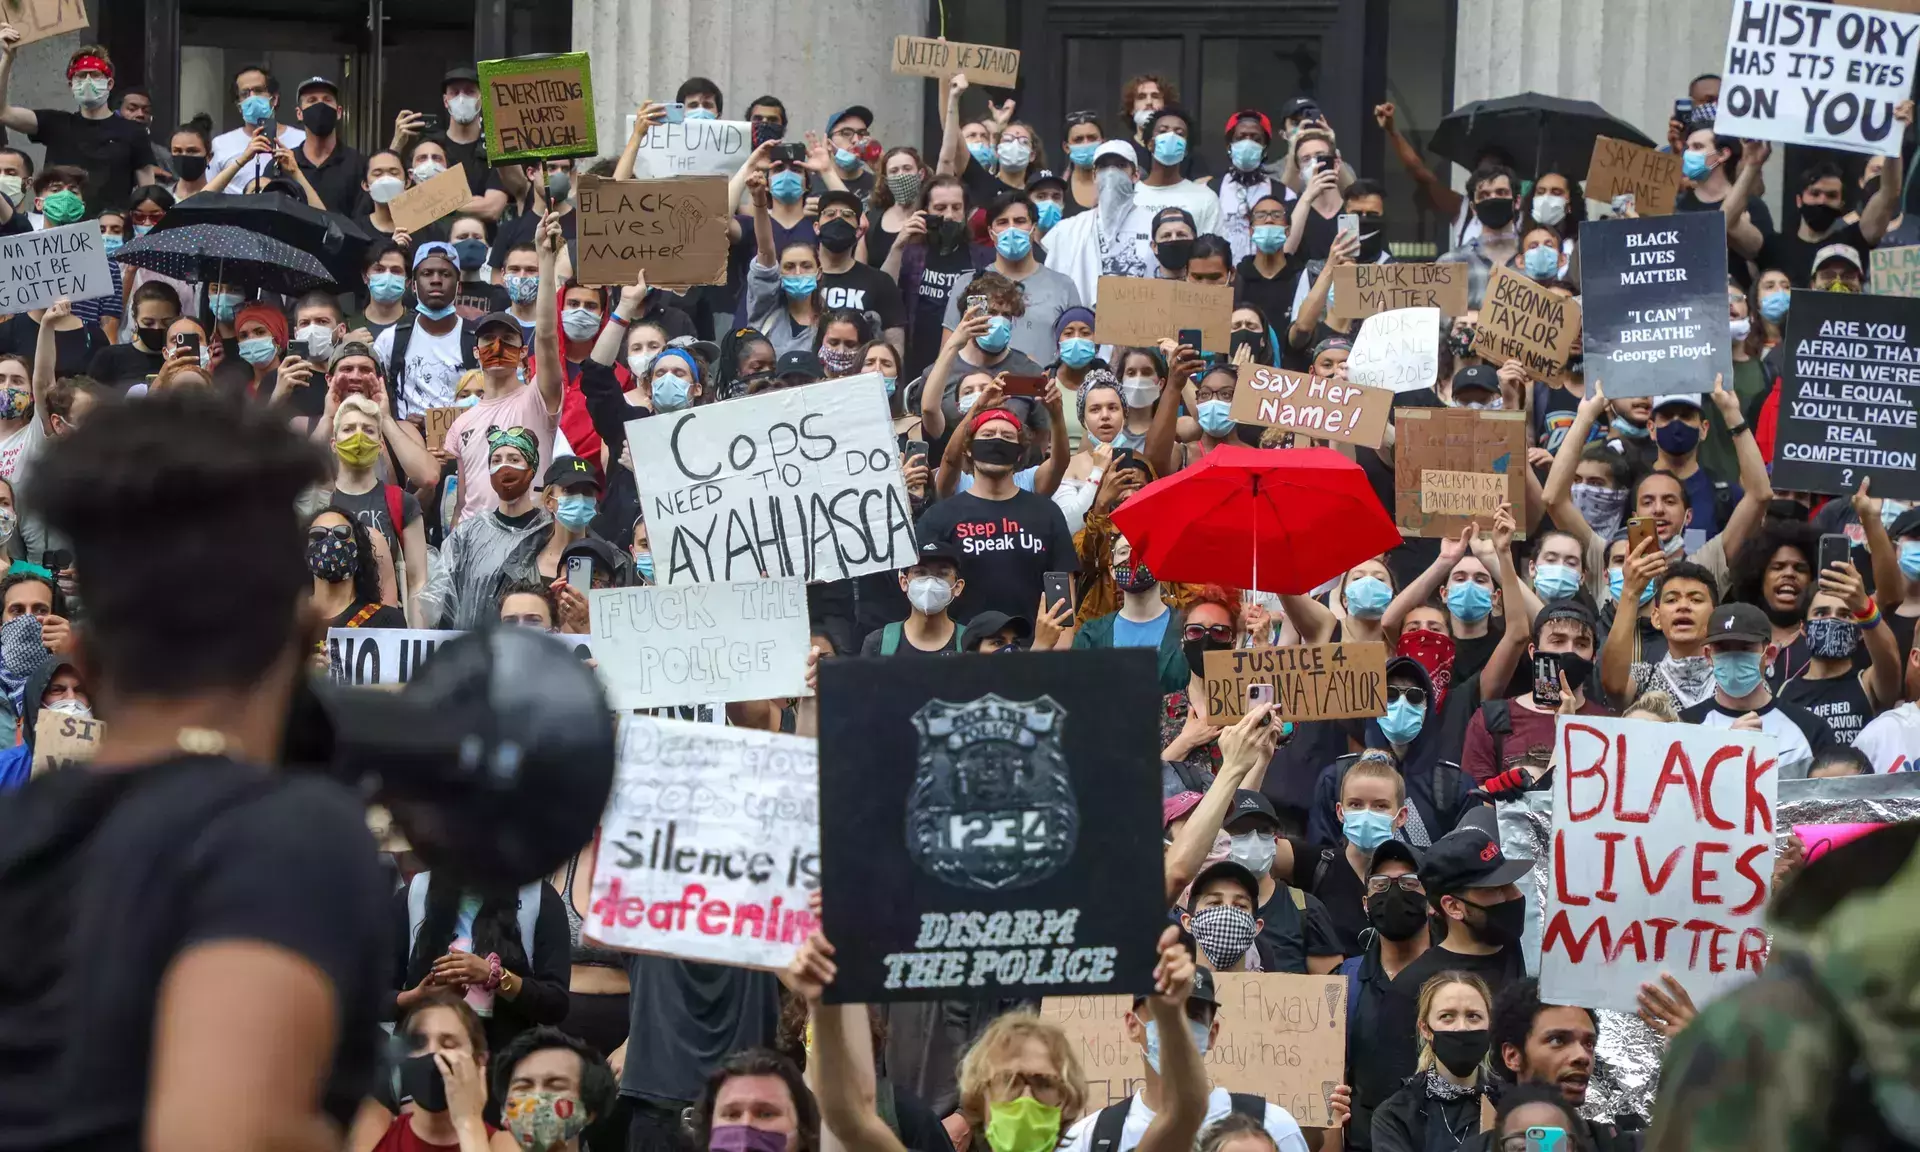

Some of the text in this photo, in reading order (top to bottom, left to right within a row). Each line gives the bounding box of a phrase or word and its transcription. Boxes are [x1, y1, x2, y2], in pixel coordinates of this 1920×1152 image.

[1737, 0, 1919, 57] HISTORY
[897, 37, 949, 68] UNITED
[974, 46, 1017, 75] STAND
[1729, 47, 1904, 86] HAS ITS EYES
[1726, 84, 1894, 142] ON YOU
[665, 155, 697, 171] THE
[1600, 142, 1676, 188] SAY HER
[580, 192, 675, 214] BLACK
[1611, 176, 1661, 207] NAME
[583, 218, 664, 236] Lives
[1626, 231, 1680, 247] BLACK
[29, 232, 93, 256] TAYLOR
[12, 257, 72, 282] NOT BE
[1630, 249, 1675, 266] LIVES
[921, 267, 961, 288] INST
[1356, 265, 1452, 289] BLACK LIVES
[1620, 268, 1688, 285] MATTER
[1359, 288, 1440, 310] MATTER
[1495, 274, 1565, 329] BREONNA
[1490, 300, 1559, 351] TAYLOR
[1644, 306, 1693, 323] CAN'T
[1620, 324, 1701, 344] BREATHE"
[1820, 320, 1906, 341] ARE YOU
[1476, 325, 1561, 377] SAY HER NAME
[1607, 342, 1717, 363] -George Floyd-
[1796, 339, 1920, 362] AFRAID THAT
[1796, 360, 1920, 383] WHEN WE'RE
[1249, 368, 1363, 405] Say Her
[1799, 381, 1913, 407] ALL EQUAL,
[1257, 397, 1363, 436] Name!
[1792, 401, 1918, 426] YOU'LL HAVE
[1826, 425, 1877, 443] REAL
[573, 460, 588, 472] H
[1783, 443, 1917, 468] COMPETITION
[655, 447, 891, 520] NEED TO DO
[1425, 472, 1503, 490] RACISM IS A
[1842, 468, 1853, 484] ?
[668, 483, 920, 585] AYAHUASCA
[956, 522, 996, 538] Step
[962, 533, 1046, 555] Speak Up.
[599, 580, 801, 640] FUCK THE
[330, 638, 380, 685] NO
[640, 635, 777, 695] POLICE
[1232, 645, 1347, 673] JUSTICE 4
[1208, 670, 1387, 717] BRENA TAYLOR
[1831, 701, 1850, 714] RED
[1827, 715, 1863, 729] SAVORY
[1564, 723, 1779, 835] BLACK
[1554, 828, 1770, 916] LIVES
[915, 908, 1080, 949] DISARM
[1541, 909, 1769, 975] MATTER
[883, 946, 1118, 989] THE POLICE
[1080, 1033, 1129, 1067] Not
[1254, 1034, 1302, 1067] has
